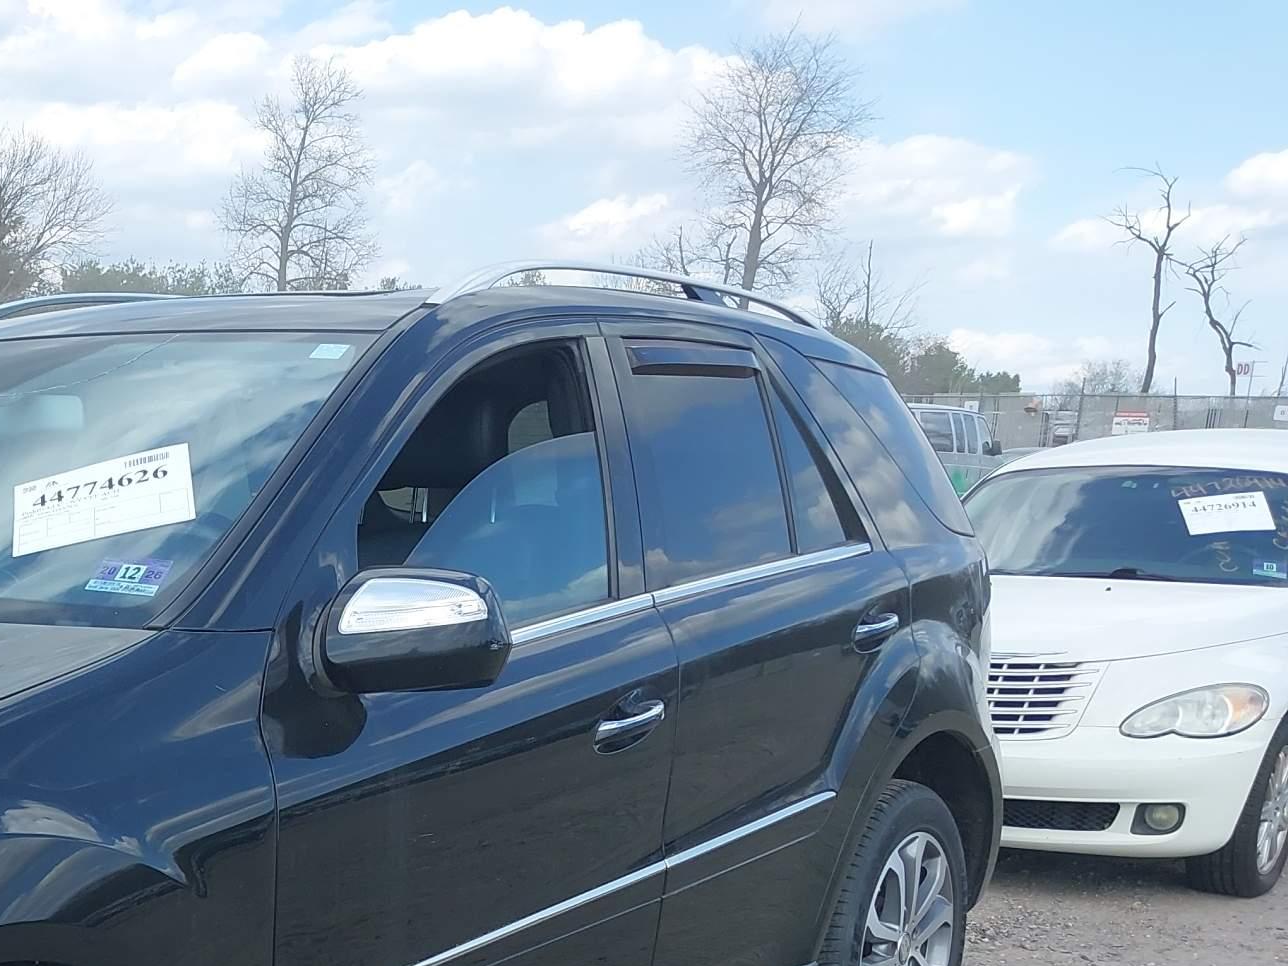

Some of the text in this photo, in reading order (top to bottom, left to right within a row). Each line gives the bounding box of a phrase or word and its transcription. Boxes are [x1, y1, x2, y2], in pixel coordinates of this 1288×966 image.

[32, 464, 169, 508] 44774626
[1191, 500, 1257, 513] 44726914
[100, 565, 163, 580] 20 12 26
